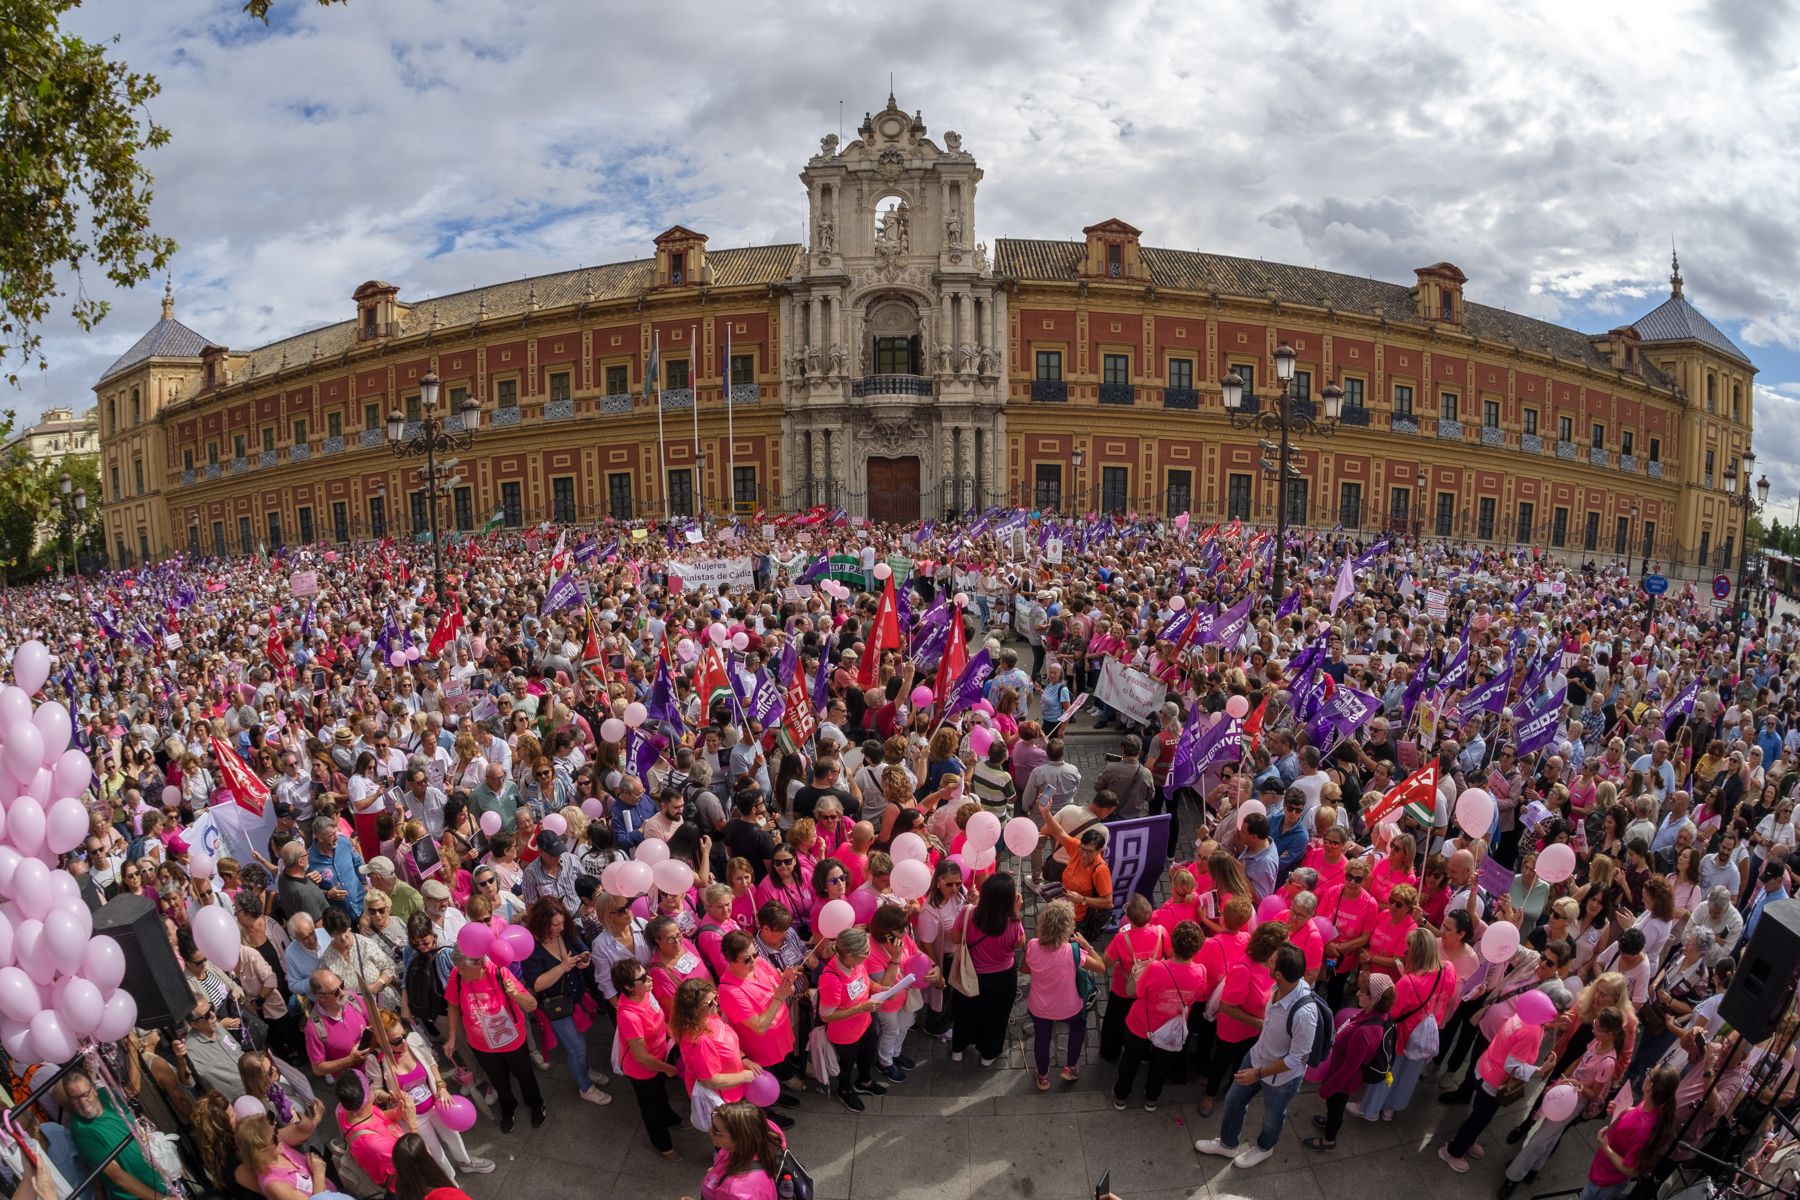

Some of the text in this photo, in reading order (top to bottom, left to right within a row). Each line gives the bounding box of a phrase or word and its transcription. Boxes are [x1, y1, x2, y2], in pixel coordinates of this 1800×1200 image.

[694, 562, 727, 571] Mujeres
[729, 569, 752, 580] Cádiz
[1127, 704, 1148, 719] solució
[787, 706, 804, 739] Huelva
[1165, 737, 1180, 746] CCO
